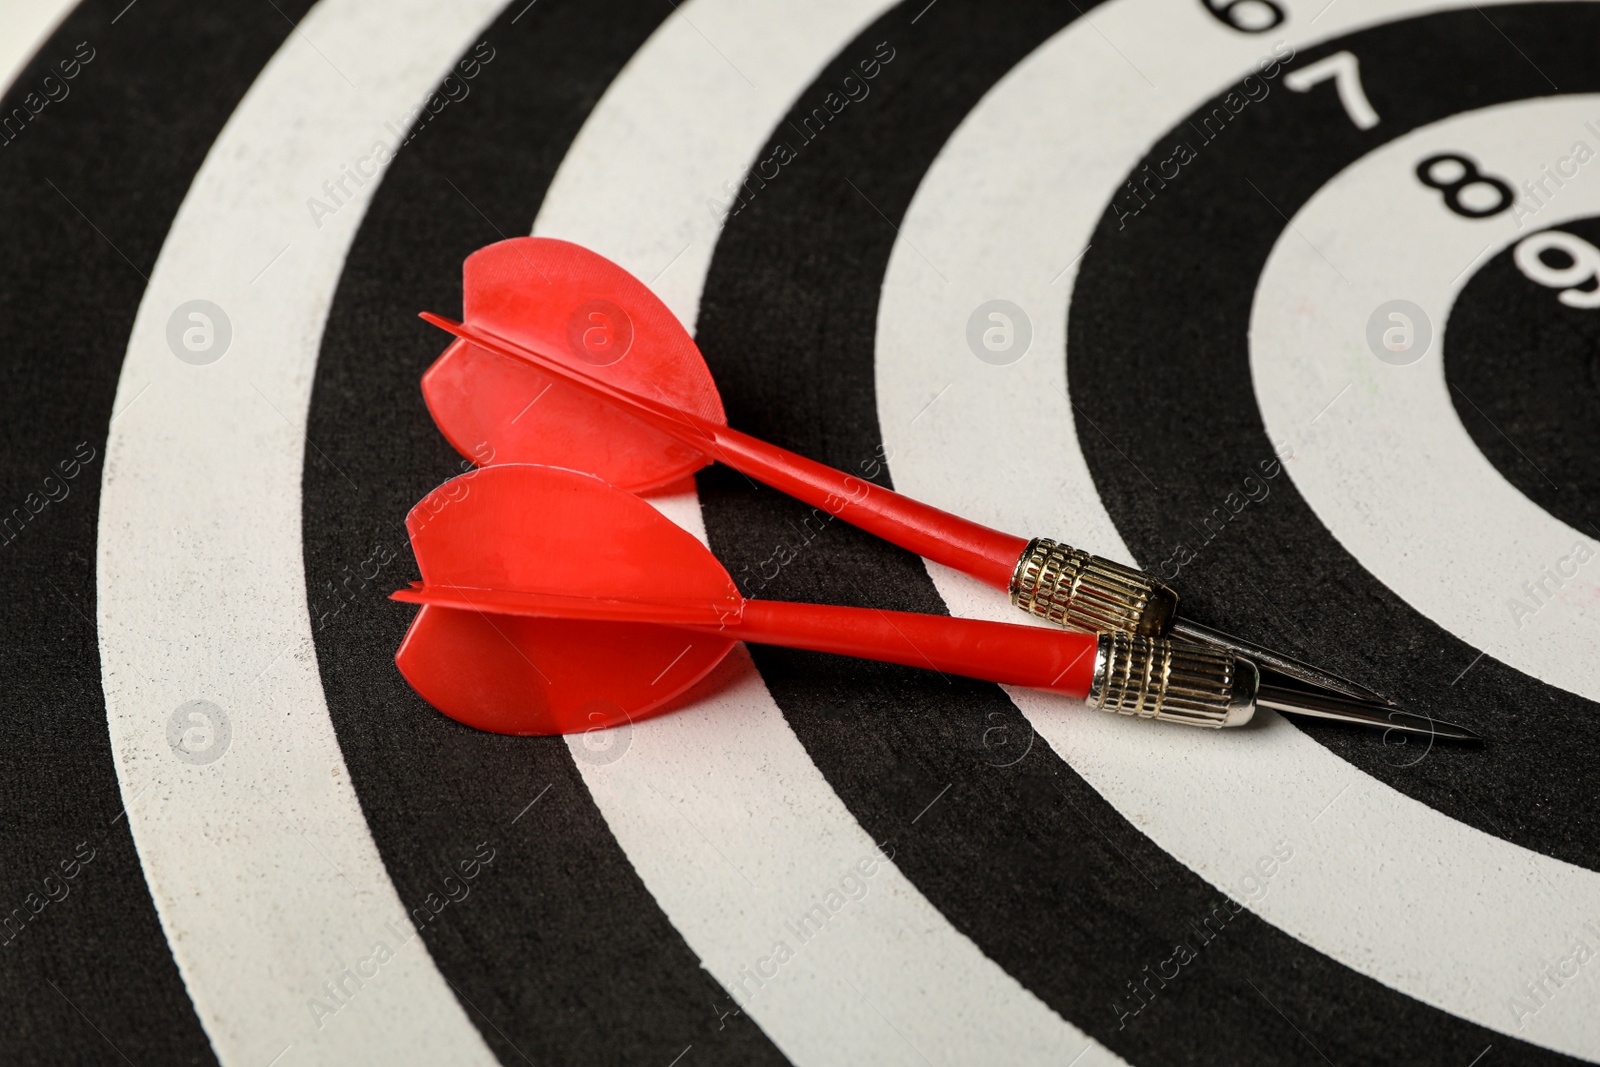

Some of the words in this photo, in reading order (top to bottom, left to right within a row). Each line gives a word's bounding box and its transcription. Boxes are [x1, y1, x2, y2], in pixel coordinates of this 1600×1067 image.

[1284, 51, 1380, 130] 7
[1415, 153, 1515, 219] 8
[1513, 230, 1600, 309] 9
